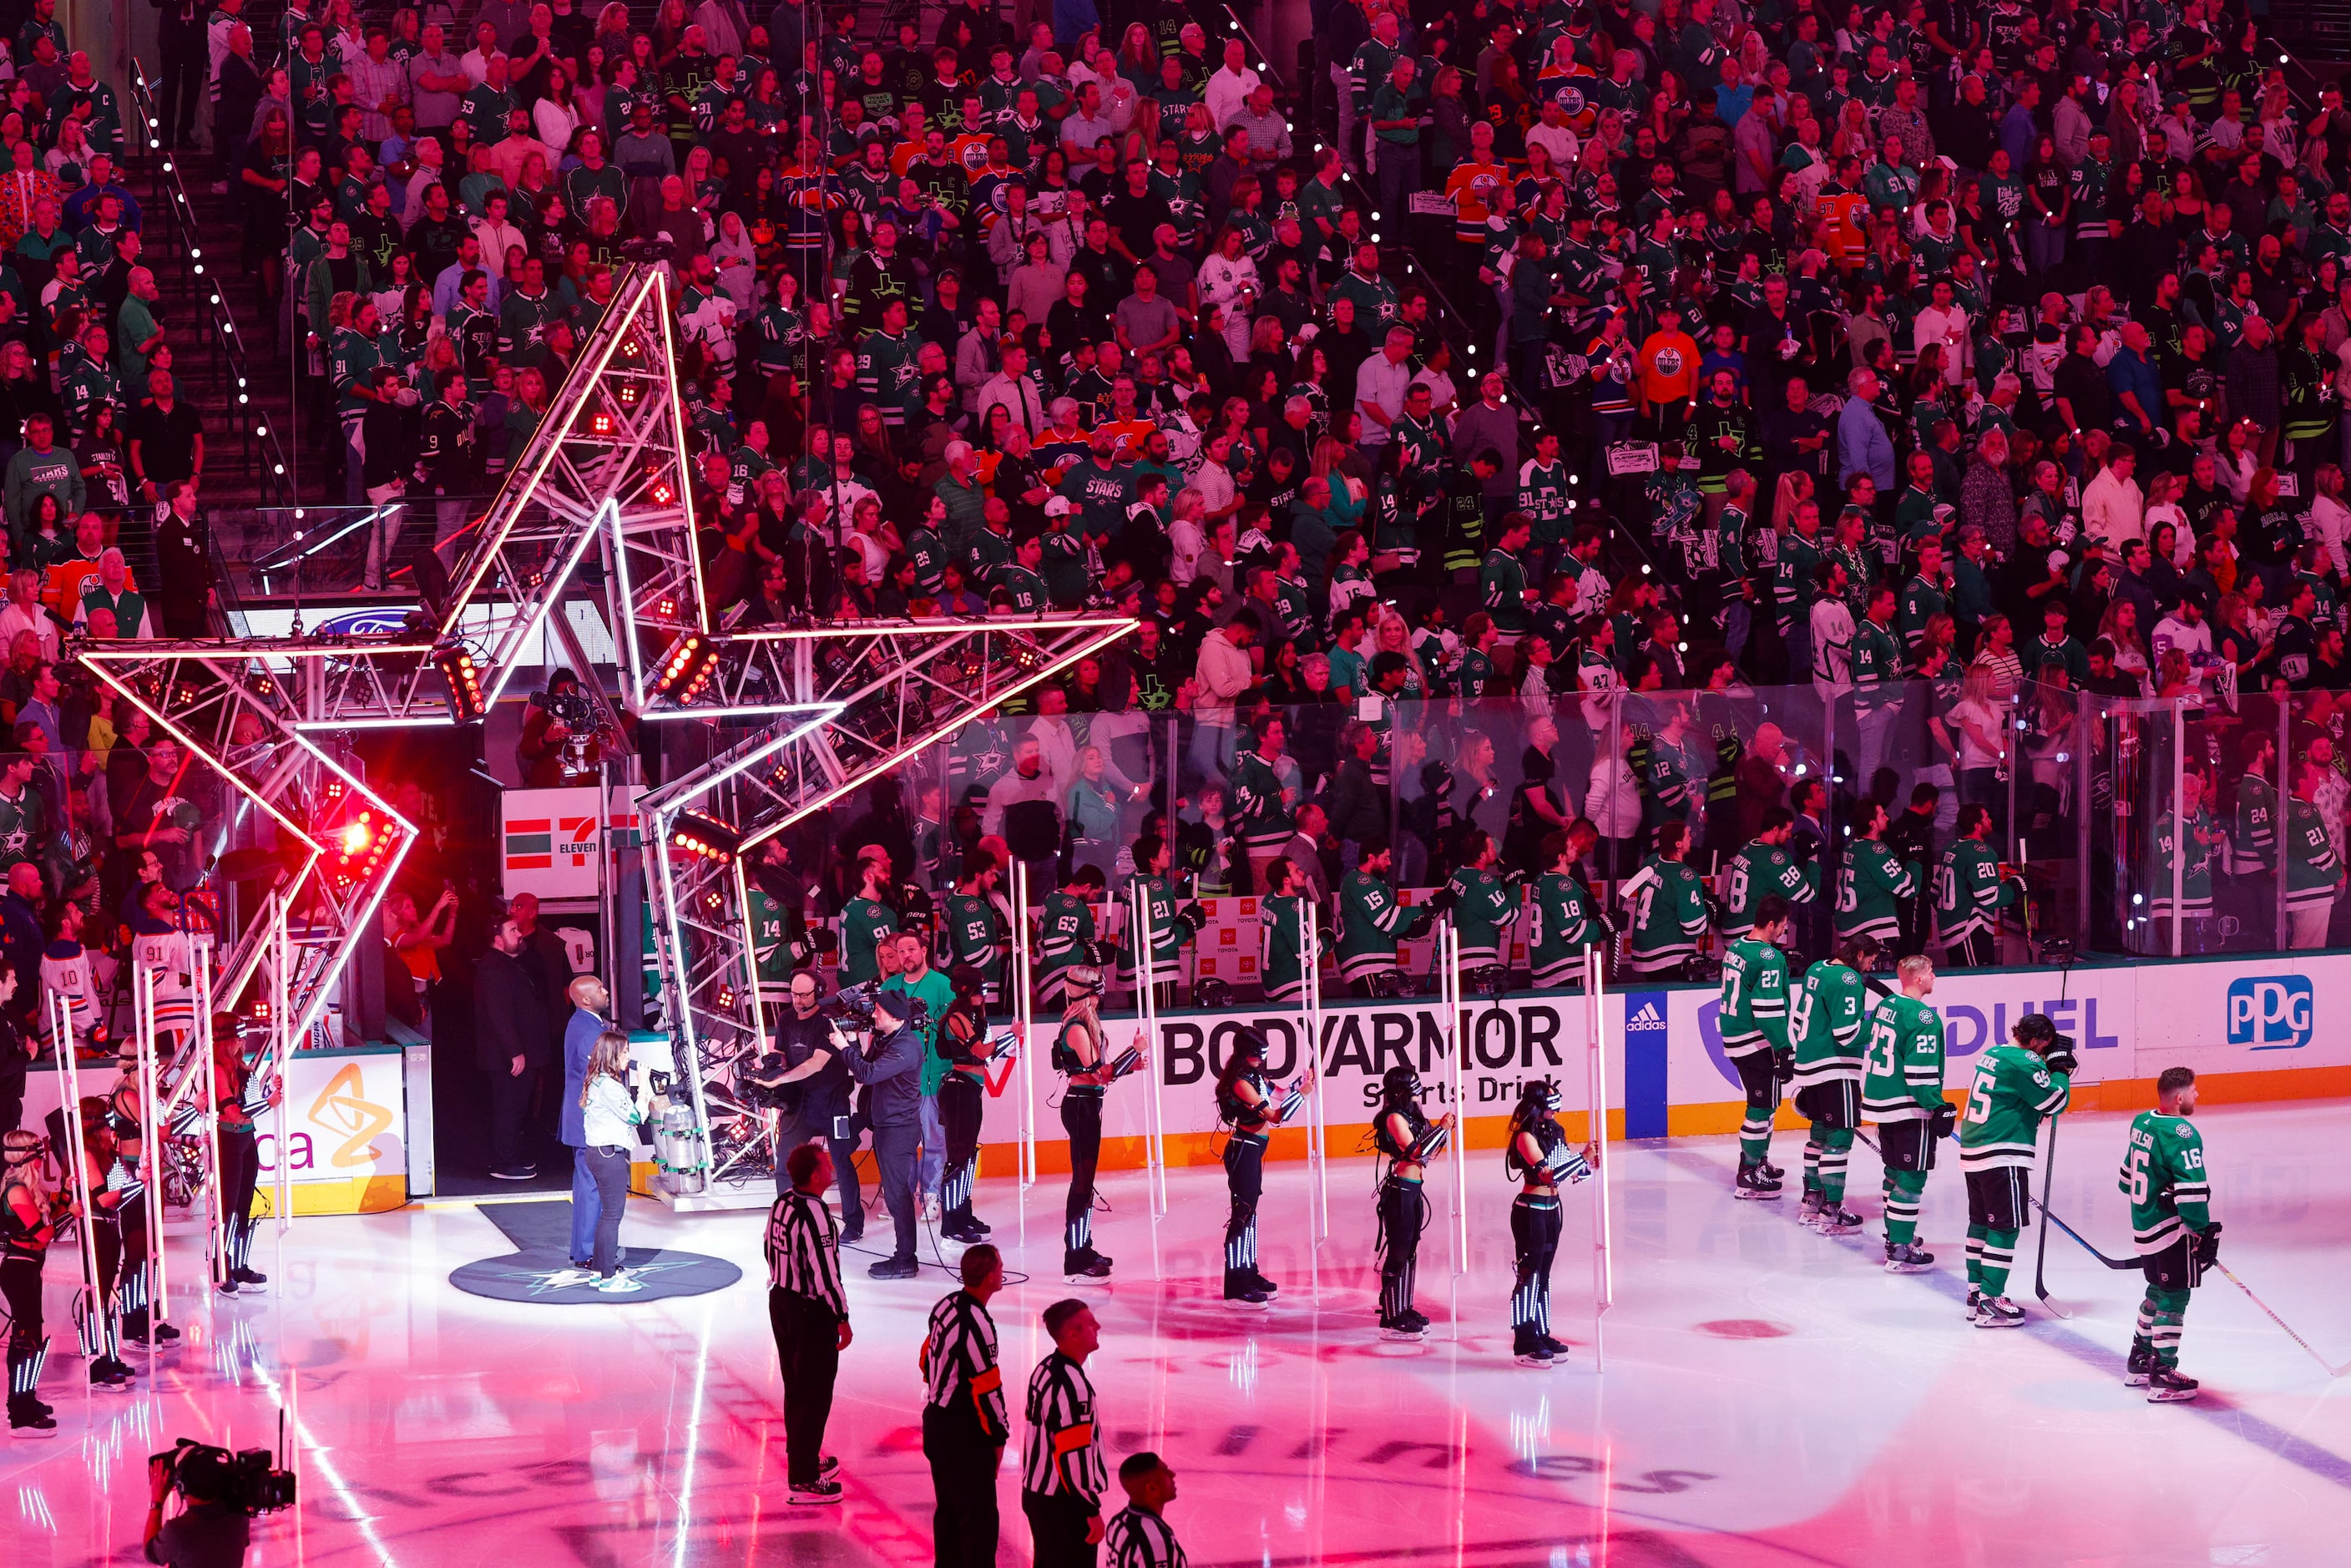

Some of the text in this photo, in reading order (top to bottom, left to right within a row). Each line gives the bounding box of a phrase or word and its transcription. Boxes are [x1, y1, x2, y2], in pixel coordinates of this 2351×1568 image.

[1159, 20, 1175, 35] 14
[1995, 26, 2019, 35] STAR
[2057, 35, 2065, 47] 9
[392, 49, 407, 62] 29
[1351, 58, 1363, 71] 14
[103, 94, 109, 105] C
[462, 99, 475, 115] 53
[1684, 100, 1691, 111] A
[699, 102, 711, 116] 91
[1160, 106, 1188, 119] STAR
[1818, 202, 1834, 215] 97
[1688, 306, 1702, 324] 21
[1879, 314, 1890, 326] 91
[2221, 321, 2235, 333] 91
[62, 343, 75, 356] 53
[335, 361, 346, 373] 91
[1656, 357, 1678, 369] OILERS
[73, 383, 88, 400] 14
[1885, 393, 1893, 407] 9
[688, 399, 702, 414] 90
[1311, 411, 1329, 420] STAR
[1395, 430, 1406, 443] 4
[1685, 423, 1696, 441] 4
[429, 434, 438, 449] 9
[732, 463, 749, 478] 16
[1086, 479, 1122, 499] STARS
[1269, 488, 1294, 507] STARS
[1380, 493, 1393, 510] 14
[1454, 496, 1472, 512] 24
[1517, 492, 1532, 508] 91
[1725, 529, 1734, 544] 4
[915, 550, 930, 568] 29
[1777, 561, 1793, 579] 14
[1014, 591, 1031, 609] 16
[1272, 598, 1292, 617] 29
[1908, 599, 1915, 615] 4
[2316, 599, 2331, 616] 14
[1828, 620, 1843, 636] 14
[2156, 640, 2165, 655] 5
[1858, 649, 1873, 665] 14
[1590, 674, 1607, 690] 47
[1000, 730, 1008, 743] A
[1629, 722, 1650, 742] 14
[1709, 723, 1723, 742] 4
[1652, 761, 1671, 779] 12
[2250, 807, 2269, 826] 24
[2158, 836, 2172, 853] 14
[2306, 826, 2324, 847] 21
[559, 842, 596, 854] ELEVEN
[1778, 865, 1802, 889] 28
[1974, 862, 1995, 880] 20
[1361, 889, 1383, 912] 15
[1486, 889, 1507, 908] 10
[1688, 890, 1699, 907] 4
[1151, 900, 1169, 920] 21
[1559, 899, 1580, 919] 18
[1636, 885, 1655, 932] 4
[760, 920, 779, 938] 14
[966, 920, 985, 941] 53
[1058, 915, 1078, 933] 63
[871, 924, 892, 942] 91
[144, 947, 162, 962] 91
[60, 970, 76, 987] 10
[1761, 969, 1780, 989] 27
[1843, 996, 1857, 1016] 3
[2231, 983, 2311, 1041] PPG
[1625, 1020, 1666, 1033] adidas
[311, 1022, 321, 1050] AUGHN
[1160, 1004, 1563, 1085] BODYARMOR
[1914, 1034, 1936, 1055] 23
[1363, 1073, 1562, 1108] Srts Drik
[2179, 1147, 2202, 1170] 16
[771, 1225, 788, 1252] 95
[821, 1236, 832, 1247] 95
